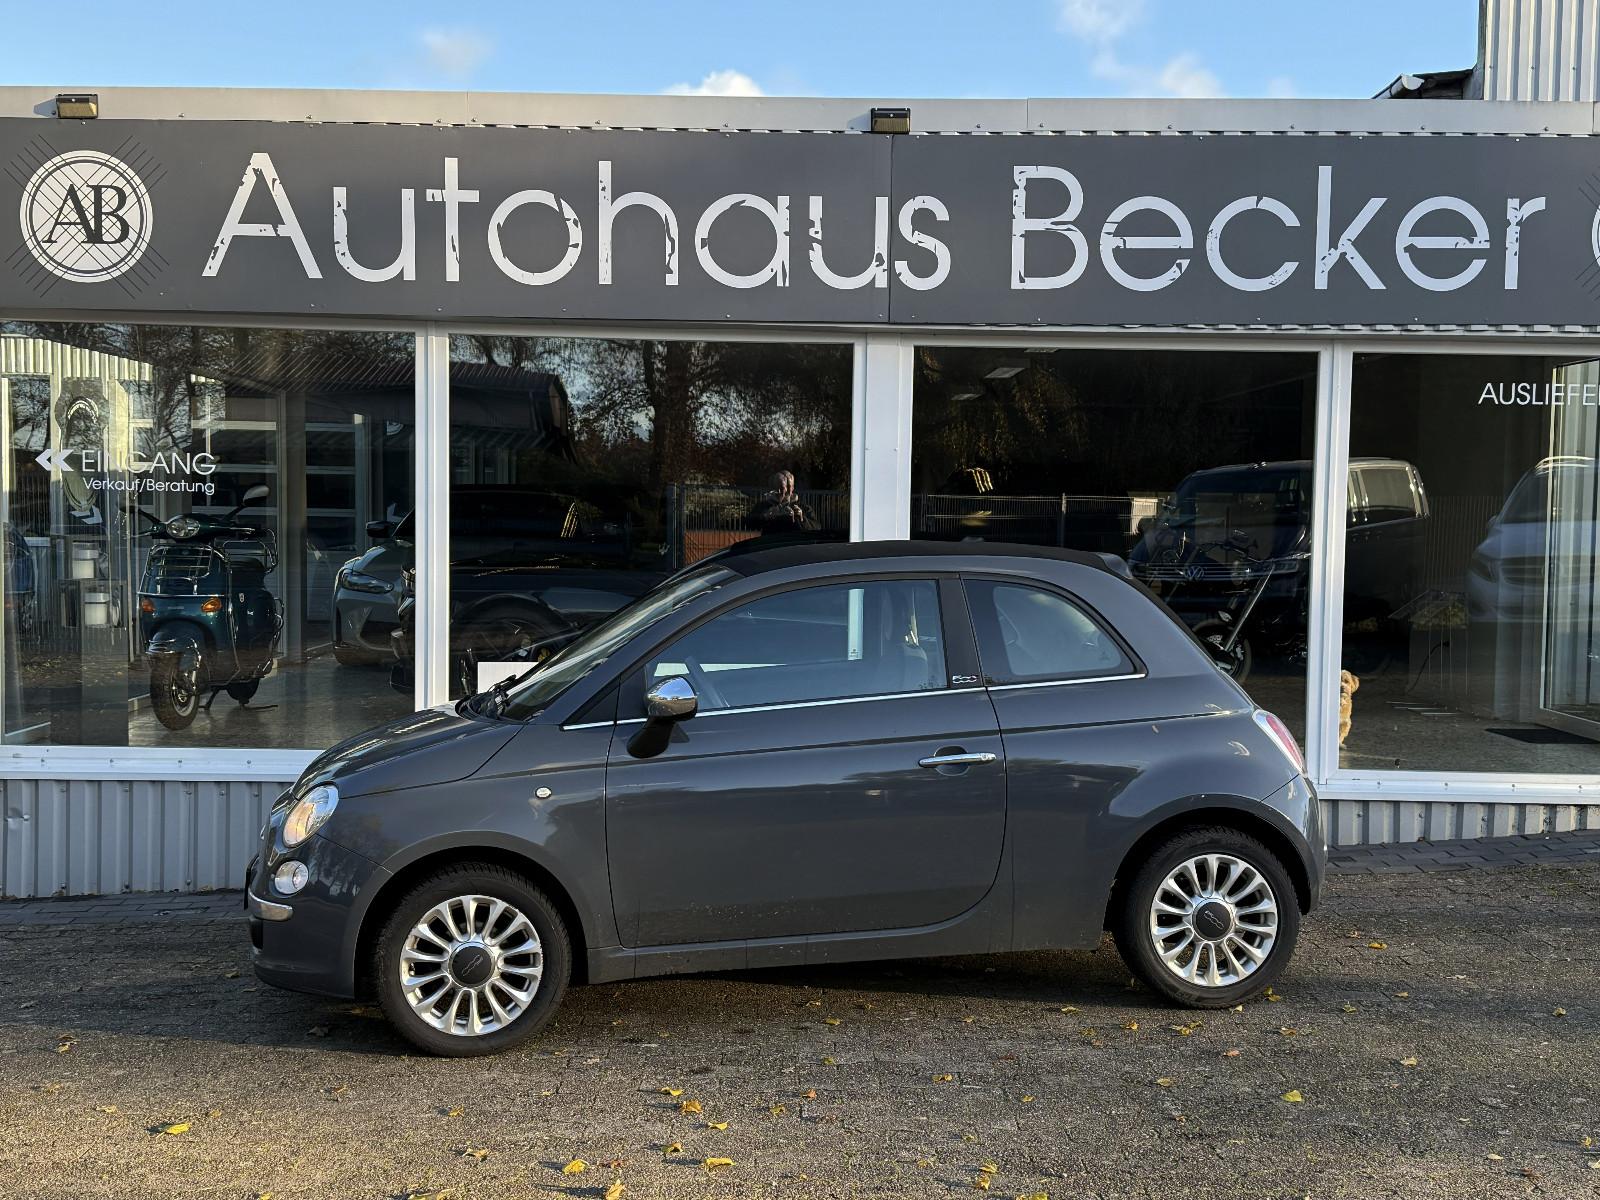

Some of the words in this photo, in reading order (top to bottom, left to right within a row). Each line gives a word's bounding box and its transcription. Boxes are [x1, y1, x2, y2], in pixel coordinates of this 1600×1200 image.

[42, 184, 130, 245] AB
[202, 153, 951, 291] Autohaus
[1011, 166, 1546, 292] Becker
[1478, 382, 1600, 406] AUSLIEFE
[83, 478, 215, 495] Verkauf/Beratung
